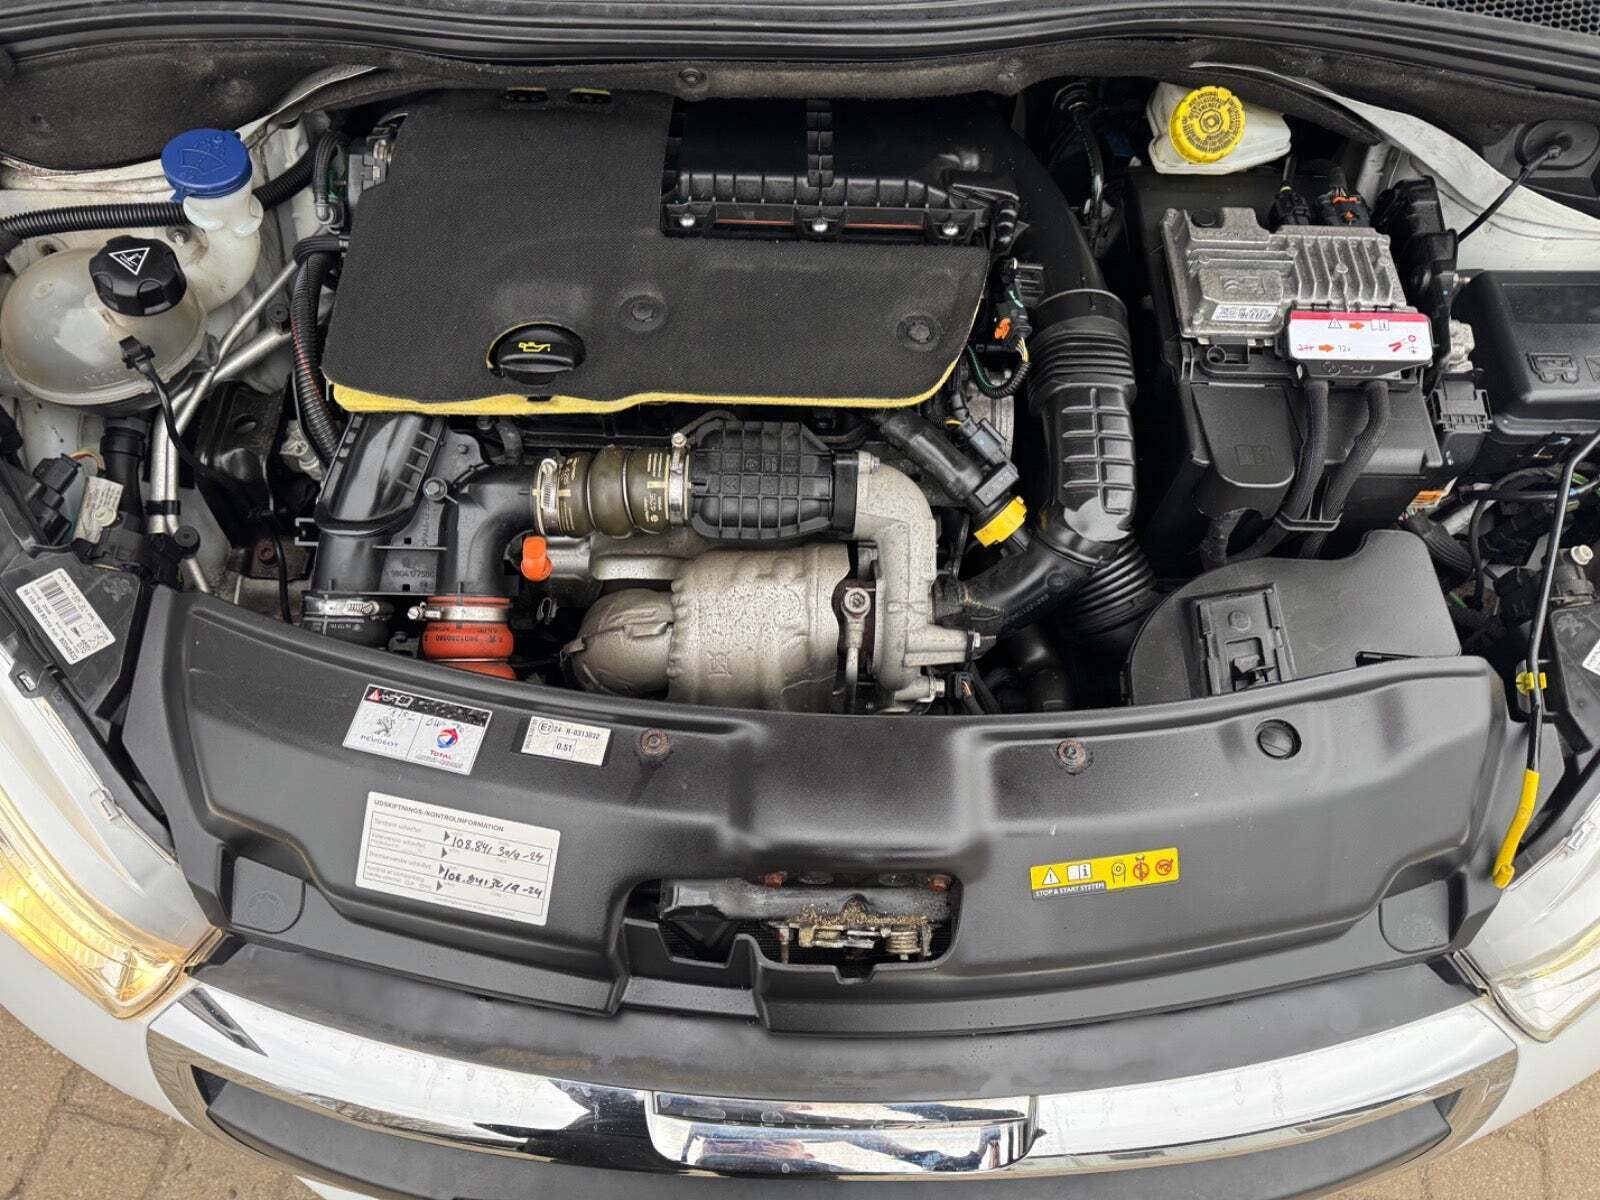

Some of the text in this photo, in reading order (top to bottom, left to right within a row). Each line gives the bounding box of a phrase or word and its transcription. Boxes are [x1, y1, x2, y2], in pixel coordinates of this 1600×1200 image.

[360, 735, 400, 748] PEUGEOT
[431, 750, 453, 761] TOTAL
[1035, 888, 1053, 897] STOP
[1059, 885, 1079, 895] START
[1080, 882, 1105, 892] SYSTEM
